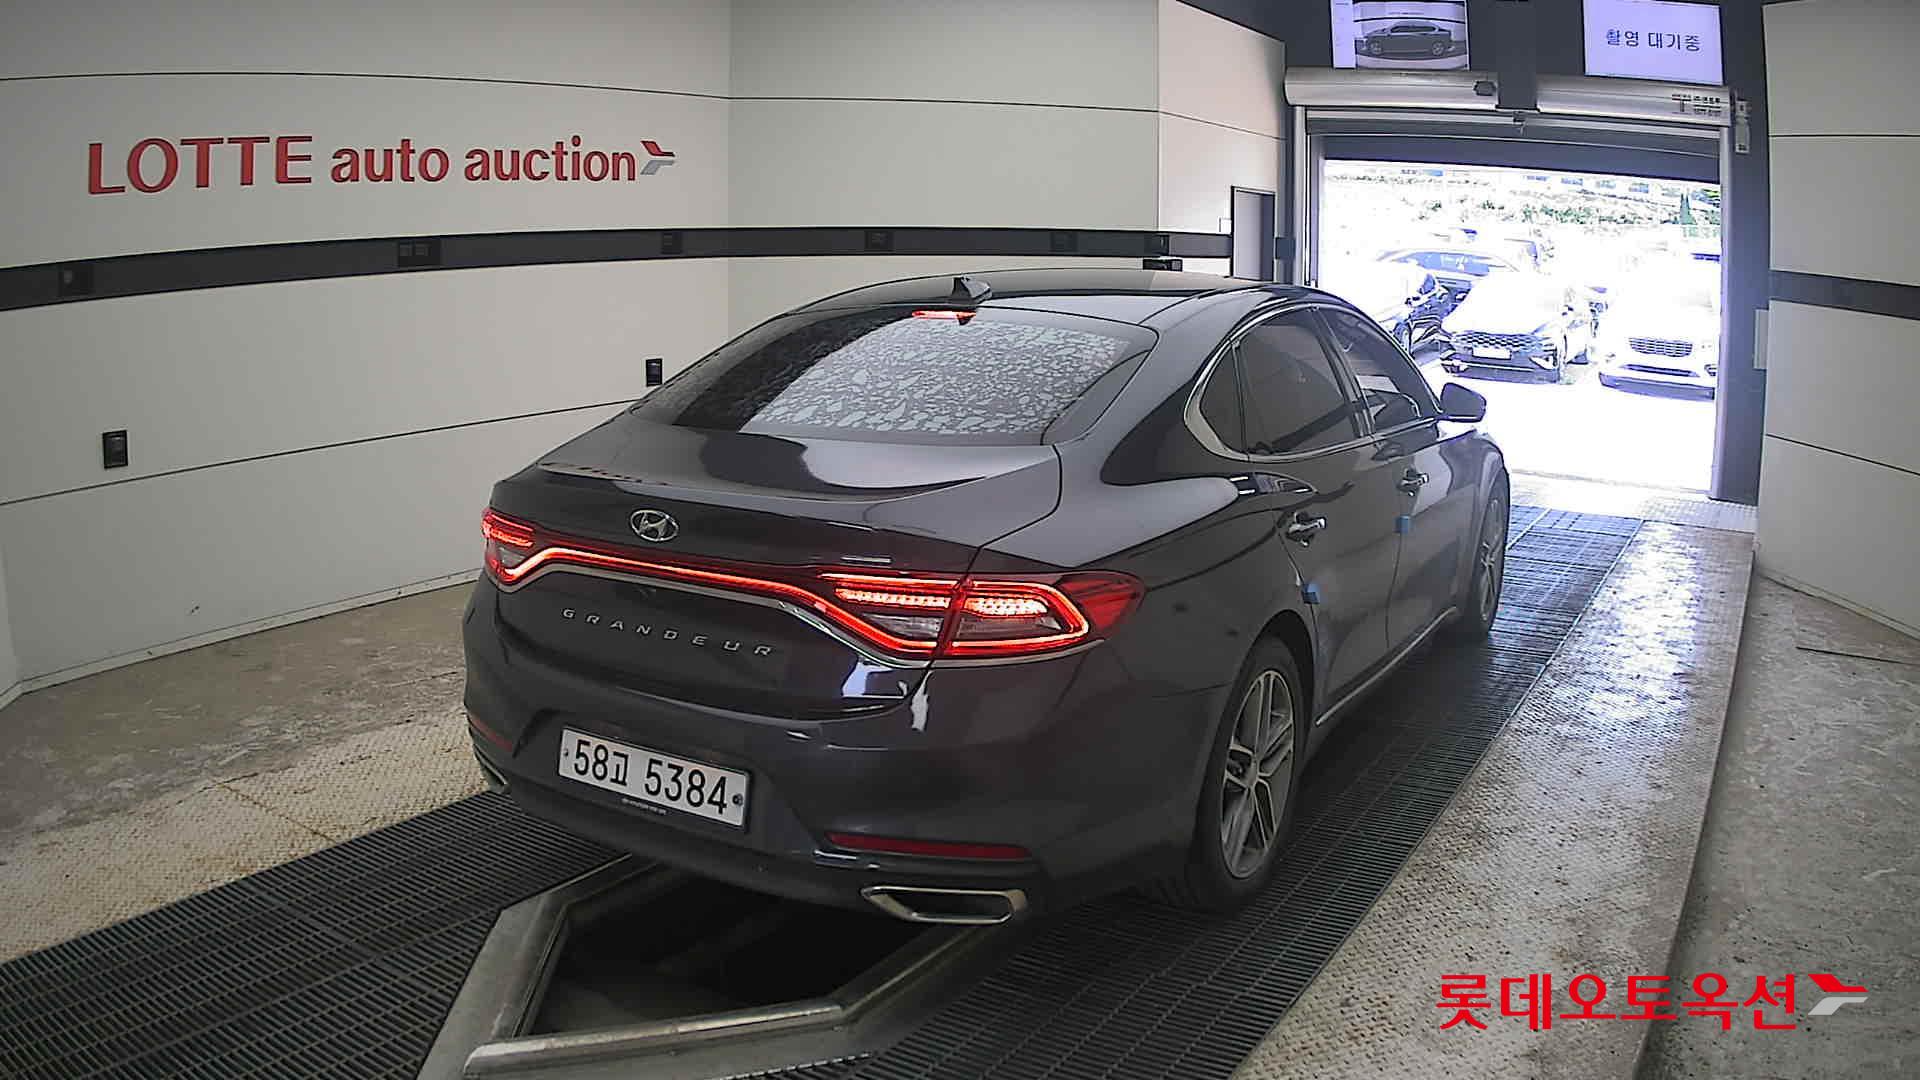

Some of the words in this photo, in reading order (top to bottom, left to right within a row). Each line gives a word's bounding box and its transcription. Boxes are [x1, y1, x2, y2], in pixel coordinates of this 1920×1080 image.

[1647, 32, 1701, 51] 대기중
[89, 136, 313, 195] LOTTE
[330, 138, 450, 183] auto
[464, 135, 637, 182] auction
[561, 608, 772, 656] GRANDEUR
[574, 739, 630, 786] 58고
[644, 758, 728, 815] 5384
